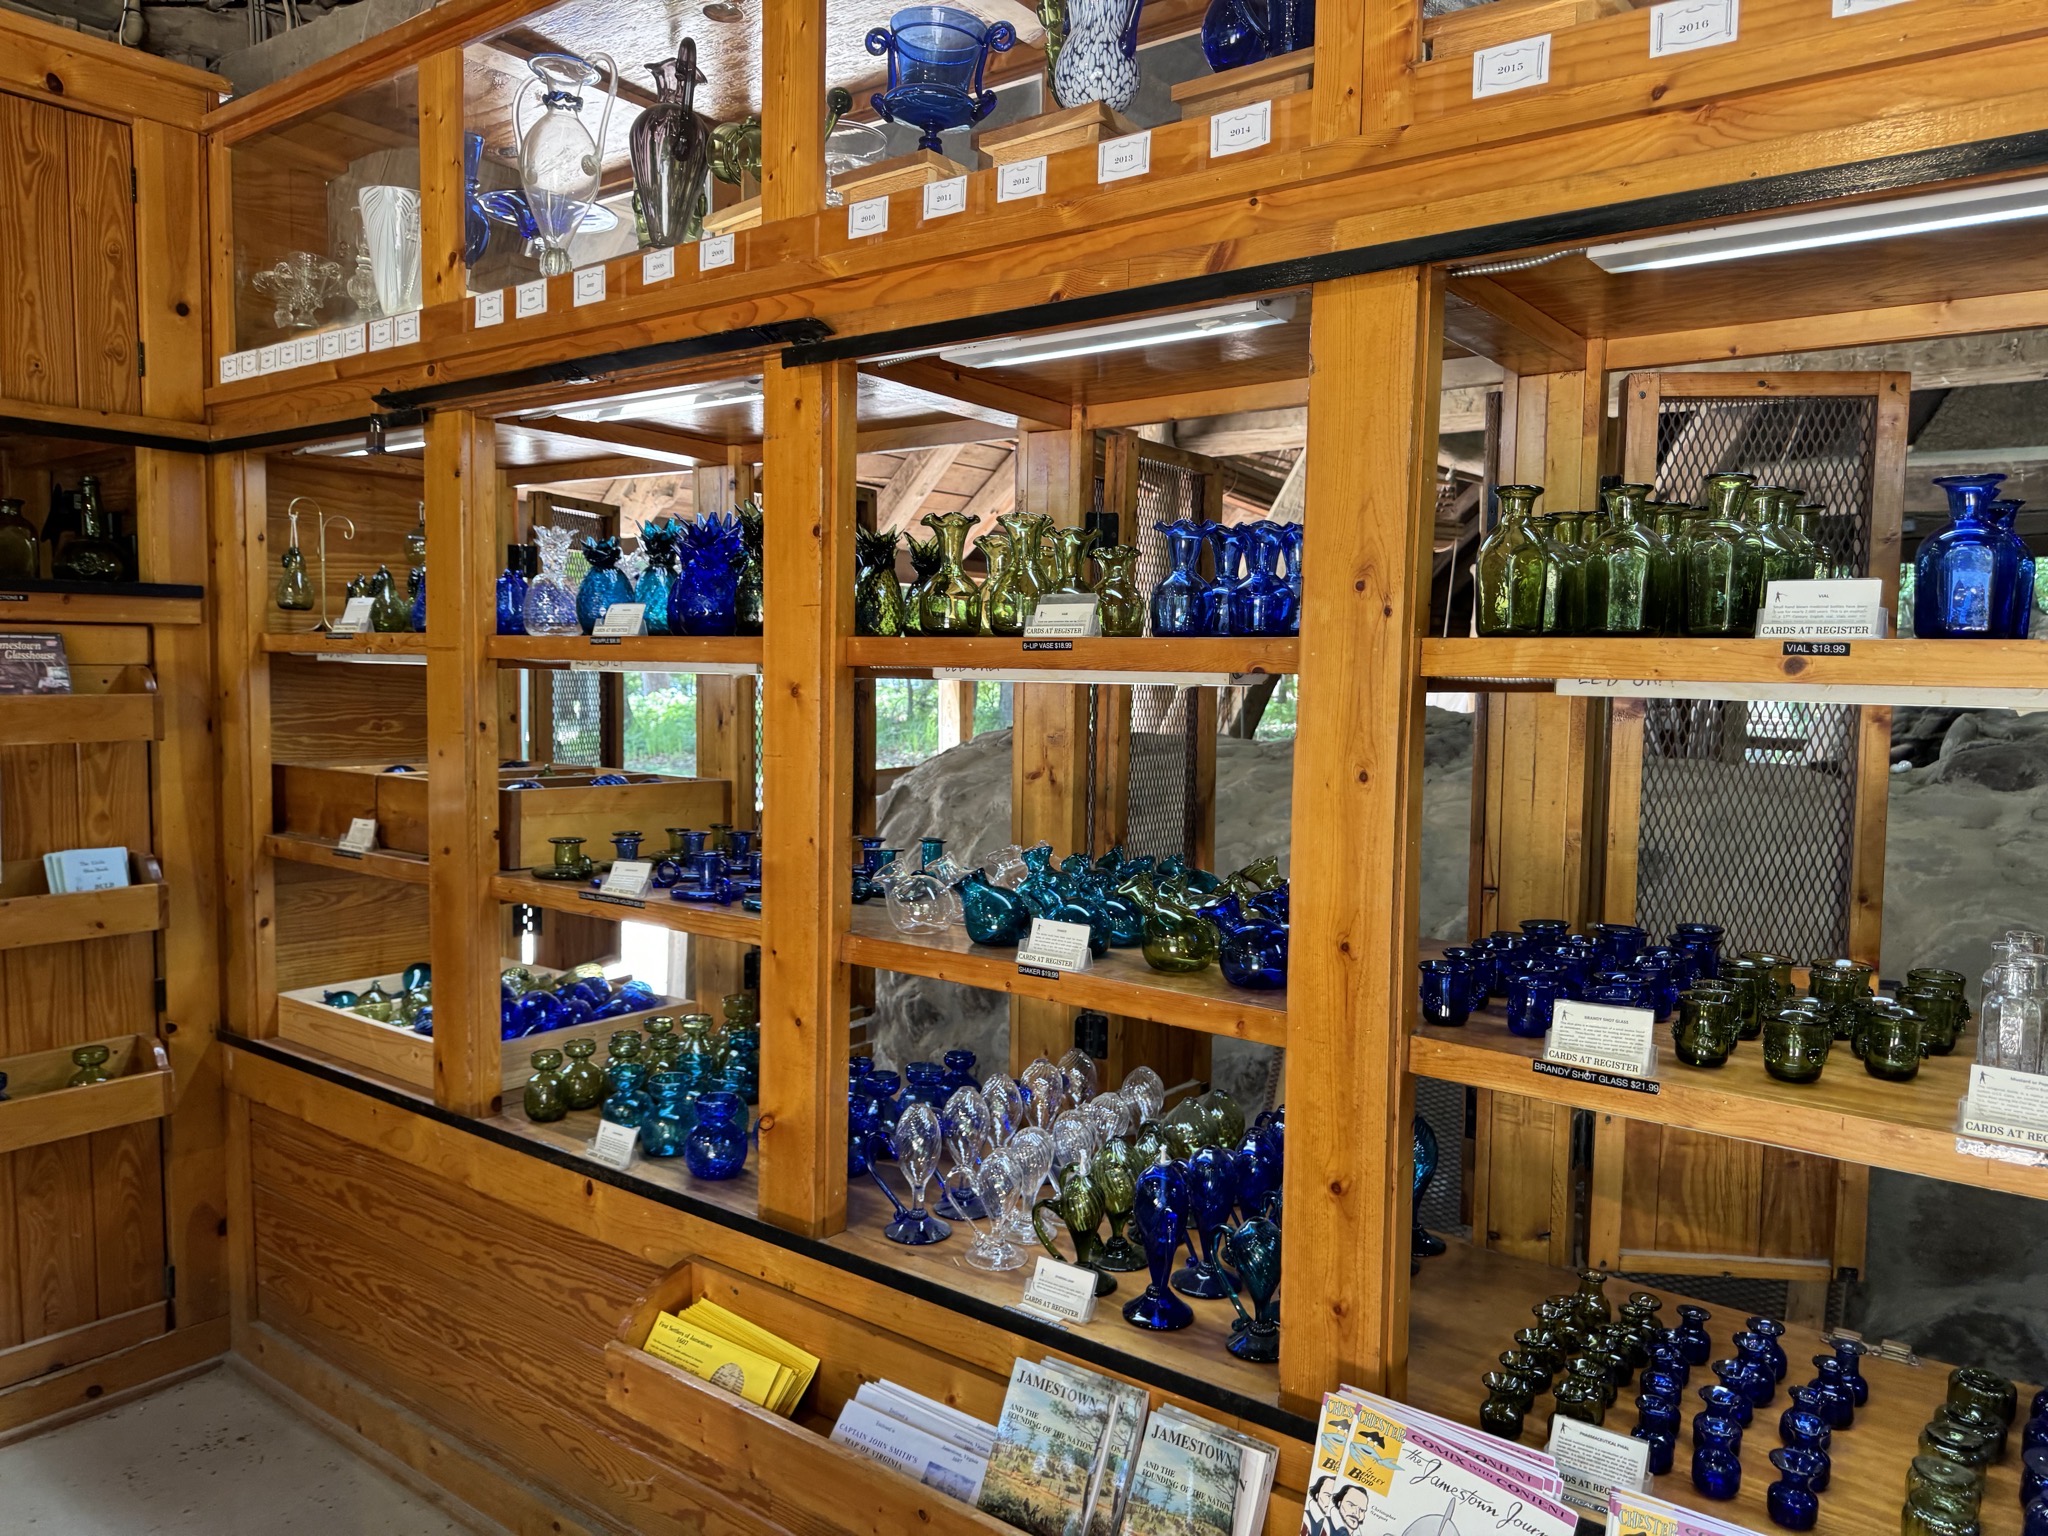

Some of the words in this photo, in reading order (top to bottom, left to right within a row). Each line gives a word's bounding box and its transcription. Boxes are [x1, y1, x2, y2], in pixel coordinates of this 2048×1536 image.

[1679, 18, 1710, 34] 2016
[1496, 61, 1525, 76] 2015
[1229, 126, 1251, 139] 2014
[1114, 153, 1134, 165] 2013
[1012, 176, 1030, 188] 2012
[936, 193, 952, 204] 2011
[861, 214, 876, 224] 2010
[1762, 626, 1796, 635] CARDS
[1798, 626, 1814, 635] AT
[1815, 626, 1869, 635] REGISTER
[4, 649, 57, 660] Glasshouse
[1786, 644, 1810, 653] VIAL
[1811, 644, 1846, 654] $18.99
[1018, 953, 1037, 962] CARDS
[1045, 957, 1073, 968] REGISTER
[1018, 965, 1041, 976] SHAKER
[1548, 1049, 1578, 1062] CARDS
[1579, 1055, 1593, 1065] AT
[1594, 1058, 1639, 1074] REGISTER
[1534, 1062, 1571, 1077] BRANDY
[1571, 1070, 1597, 1082] SHOT
[1598, 1075, 1629, 1088] GLASS
[1630, 1080, 1660, 1093] $21.99
[1965, 1121, 2004, 1136] CARDS
[2006, 1128, 2024, 1139] AT
[1024, 1294, 1043, 1306] CARDS
[1042, 1300, 1052, 1309] AT
[1051, 1303, 1080, 1319] REGISTER
[658, 1320, 669, 1329] First
[1016, 1369, 1102, 1408] JAMESTOWN
[1009, 1403, 1025, 1414] AND
[1025, 1407, 1040, 1420] THE
[1325, 1399, 1354, 1420] CHES
[1007, 1412, 1046, 1431] FOUNDING
[1042, 1424, 1053, 1434] OF
[1052, 1428, 1067, 1441] THE
[1066, 1434, 1093, 1452] NATION
[1357, 1409, 1408, 1444] CHESTER
[839, 1422, 867, 1440] CAPTAIN
[869, 1436, 888, 1450] JOHN
[888, 1446, 919, 1464] SMITH'S
[1151, 1424, 1238, 1468] JAMESTOWN
[844, 1436, 860, 1448] MAP
[860, 1444, 871, 1454] OF
[871, 1449, 903, 1471] VIRGINIA
[1402, 1448, 1425, 1467] the
[1143, 1460, 1160, 1472] AND
[1160, 1465, 1176, 1479] THE
[1411, 1433, 1466, 1466] COMIX
[1496, 1477, 1566, 1518] CONTENT
[1141, 1467, 1180, 1491] FOUNDING
[1192, 1488, 1206, 1501] THE
[1207, 1493, 1231, 1512] NATION
[1409, 1458, 1500, 1518] Jamestown
[1560, 1473, 1577, 1485] RDS
[1578, 1480, 1592, 1490] AT
[1618, 1508, 1679, 1536] CHESTER
